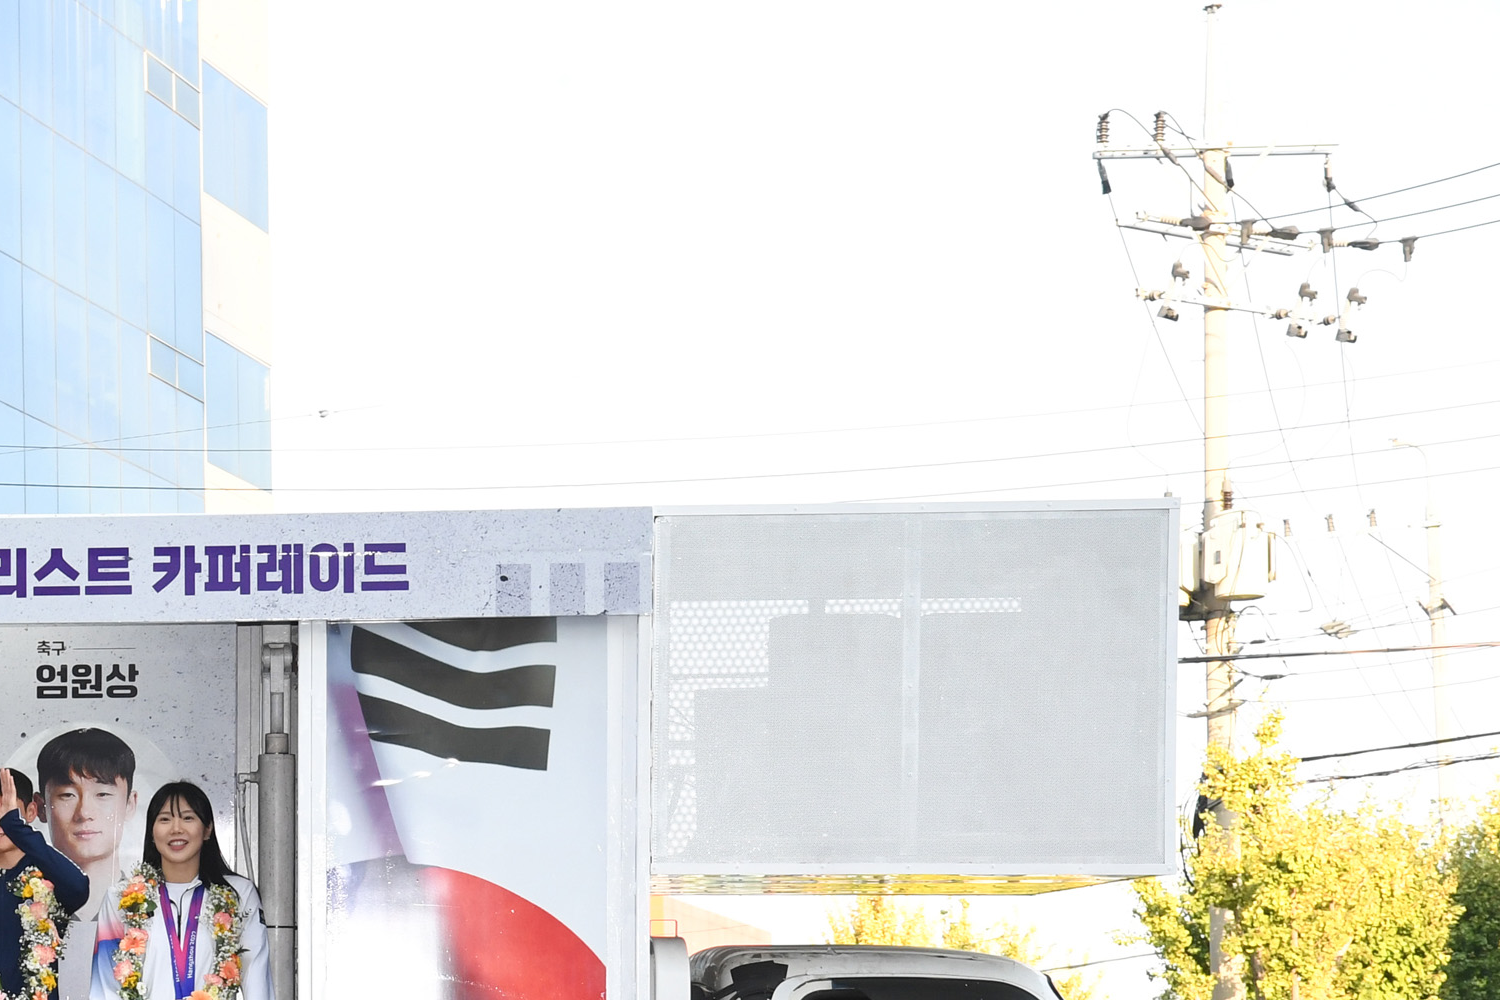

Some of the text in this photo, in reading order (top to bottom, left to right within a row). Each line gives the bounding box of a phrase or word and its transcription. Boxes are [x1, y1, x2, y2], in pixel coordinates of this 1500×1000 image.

[152, 541, 411, 595] 카퍼레이드
[37, 640, 66, 656] 축구
[36, 663, 139, 699] 엄원상
[187, 945, 195, 979] Hangzhou
